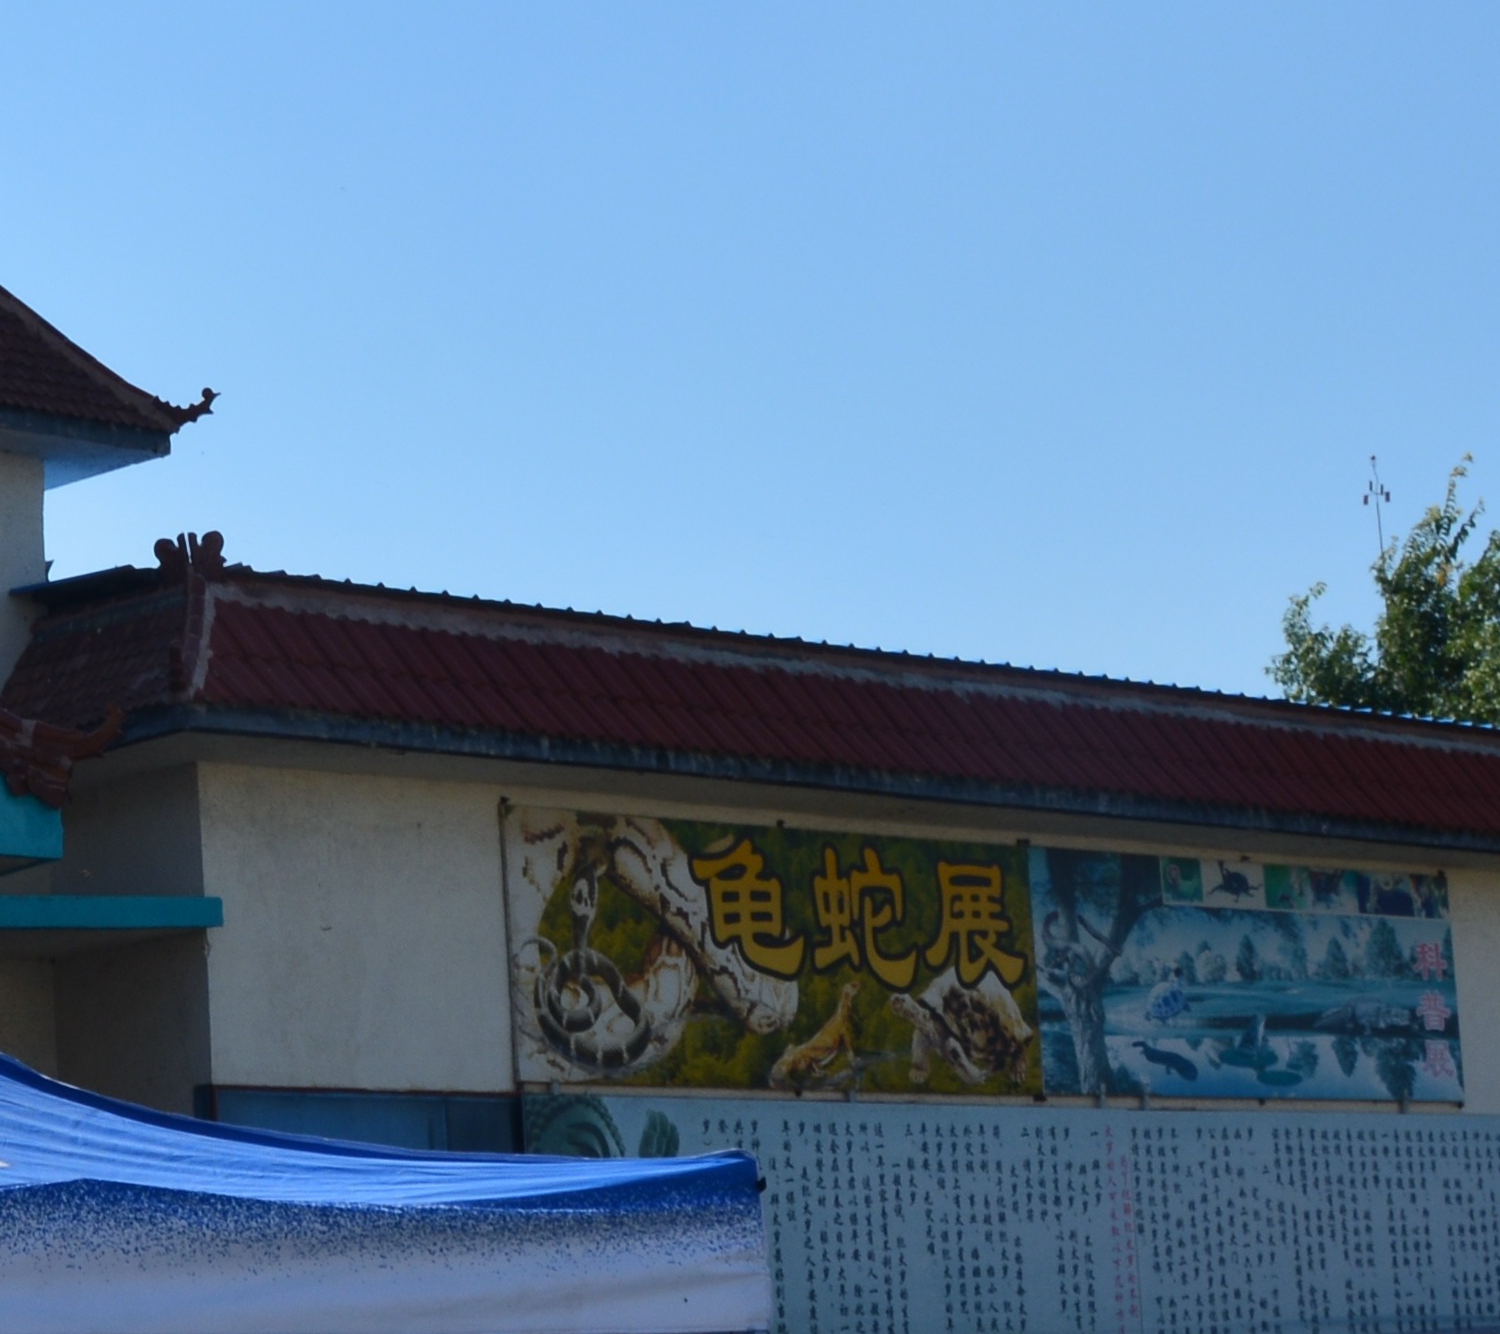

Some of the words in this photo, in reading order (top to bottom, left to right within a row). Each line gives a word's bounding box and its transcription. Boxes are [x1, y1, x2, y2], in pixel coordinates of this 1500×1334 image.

[692, 837, 1028, 989] 龟蛇展
[1414, 942, 1454, 1079] 科普展
